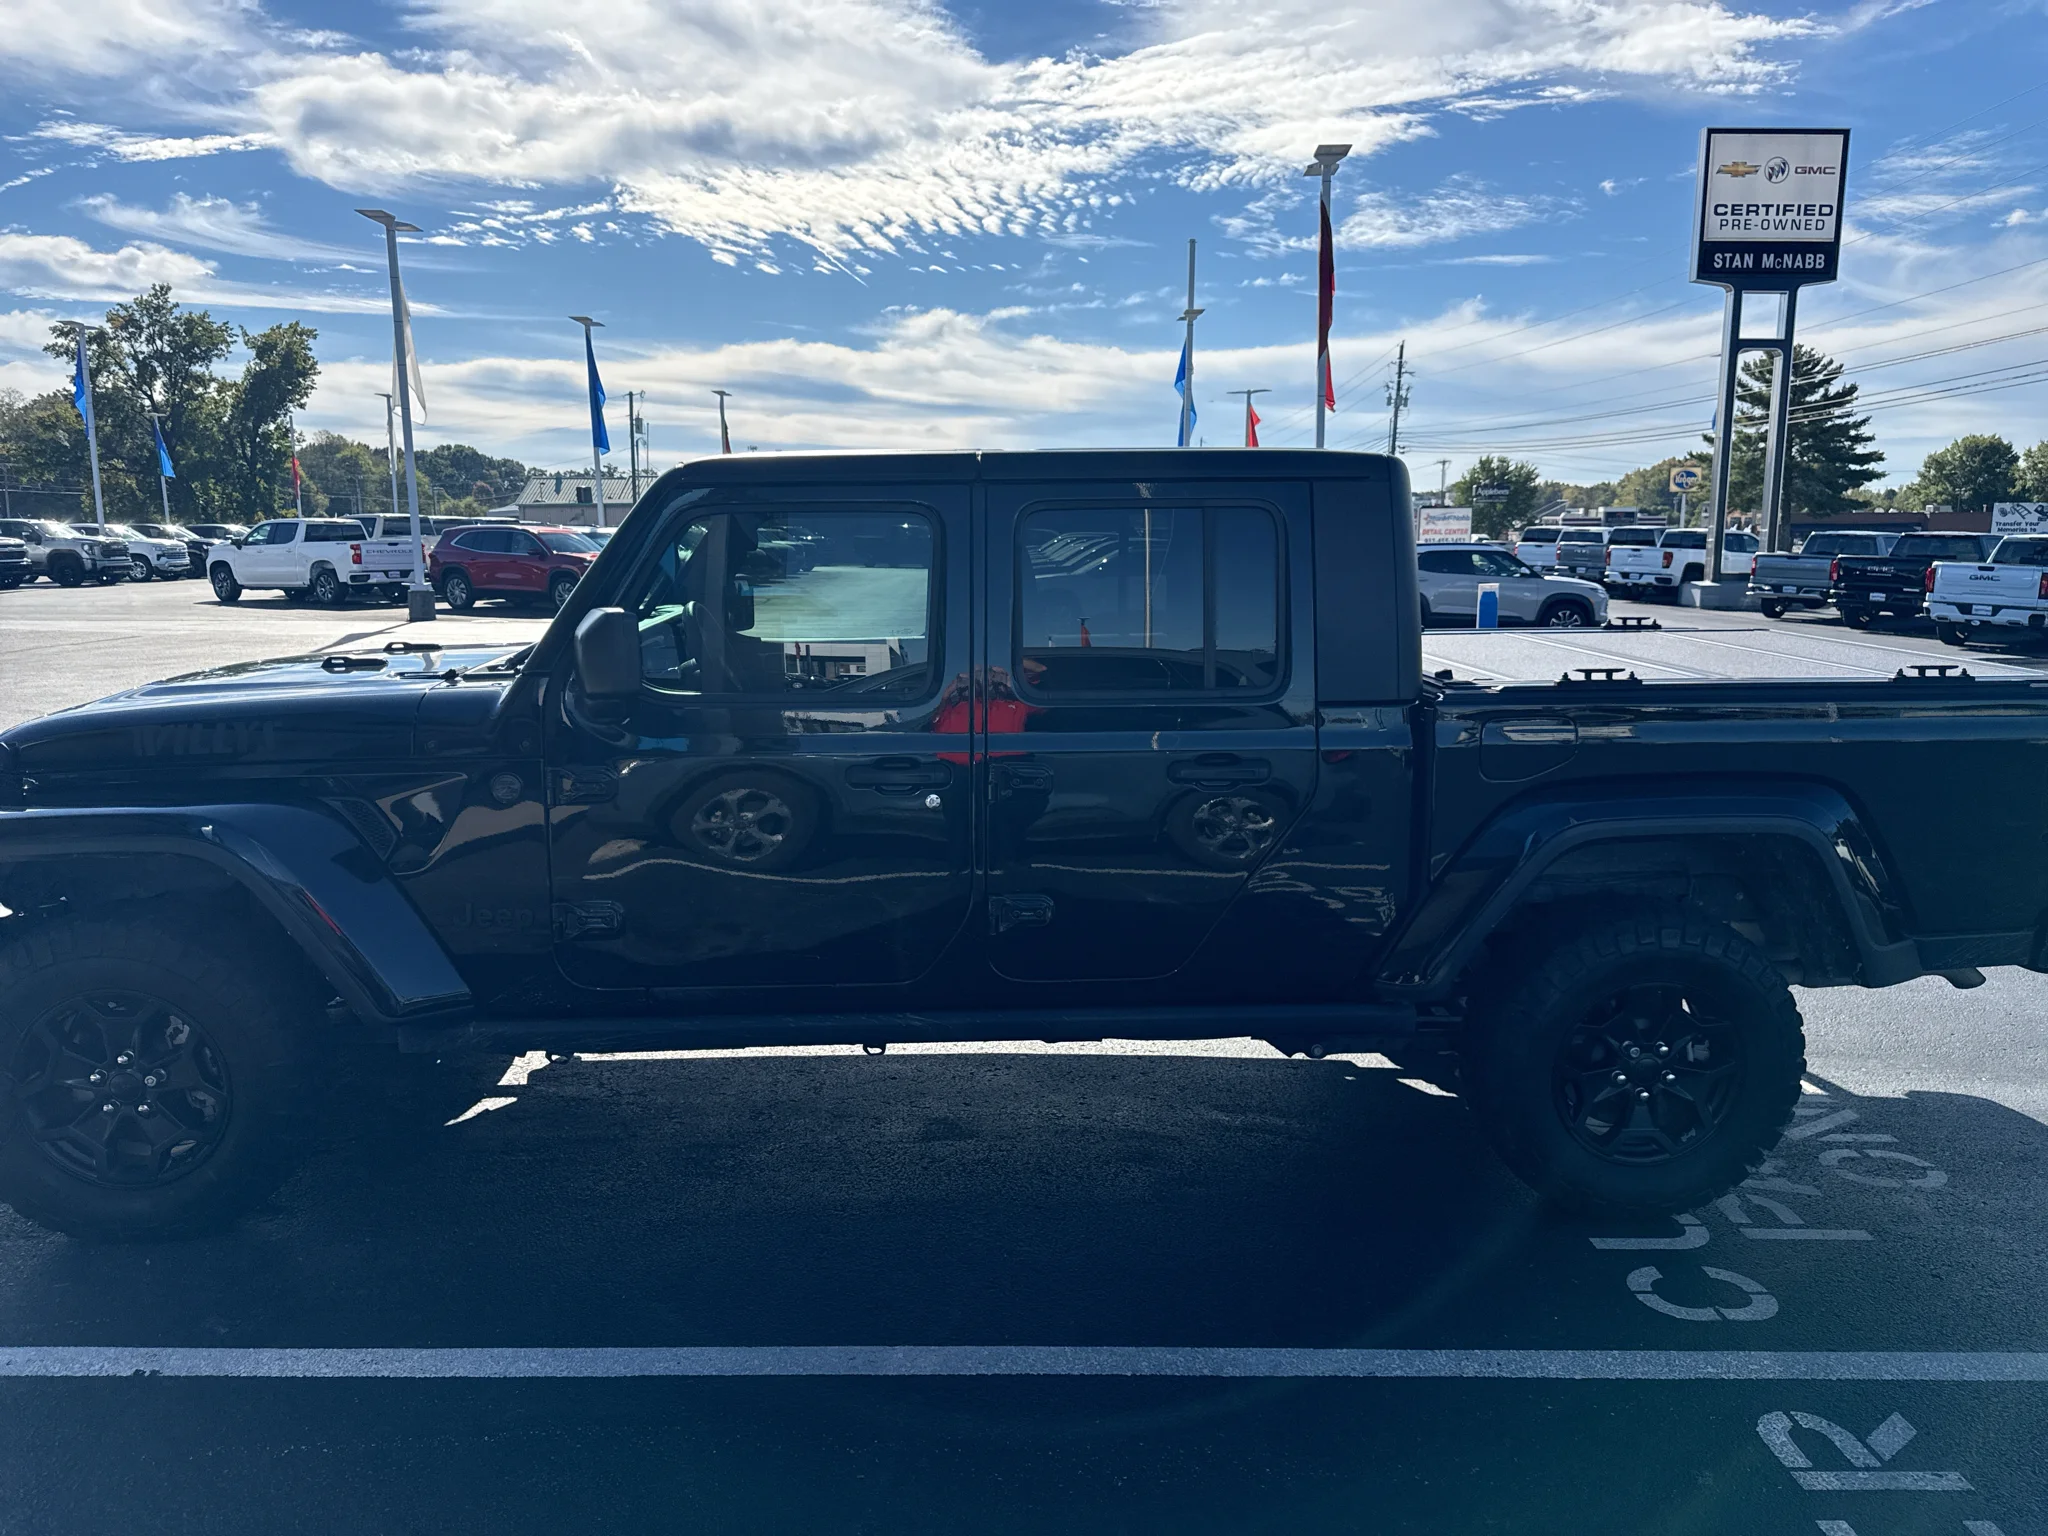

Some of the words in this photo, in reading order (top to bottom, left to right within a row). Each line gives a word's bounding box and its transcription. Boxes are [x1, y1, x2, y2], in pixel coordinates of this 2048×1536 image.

[1794, 166, 1836, 175] GMC
[1713, 203, 1834, 216] CERTIFIED
[1719, 218, 1825, 231] PRE-OWNED
[1713, 253, 1754, 269] STAN
[1761, 253, 1825, 269] McNABB
[1422, 527, 1442, 535] DETAIL
[1444, 527, 1469, 535] CENTER
[1968, 574, 2001, 582] GMC
[453, 902, 535, 934] Jeep
